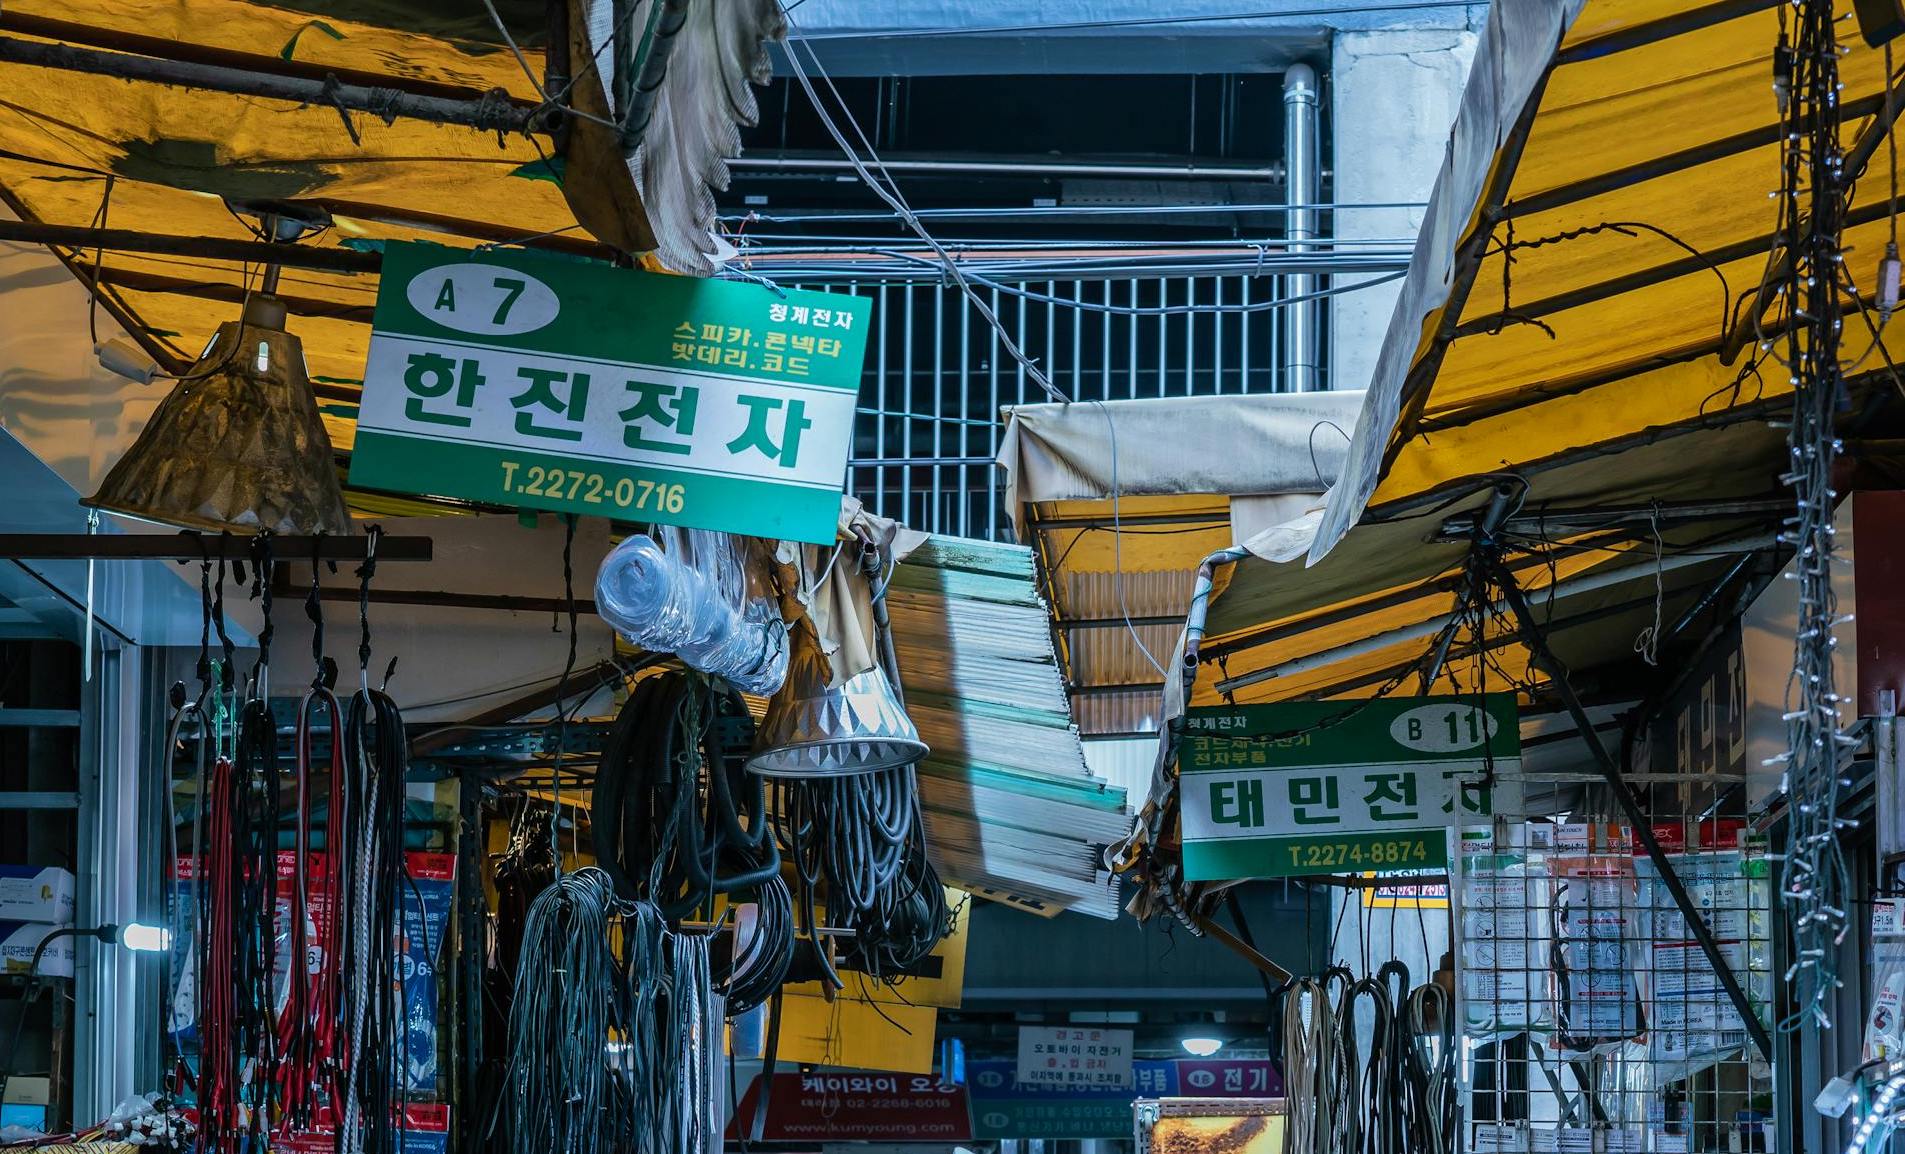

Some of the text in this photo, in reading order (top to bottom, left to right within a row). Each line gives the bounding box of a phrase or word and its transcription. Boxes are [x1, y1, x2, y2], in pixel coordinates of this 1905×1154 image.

[434, 277, 526, 325] A 7
[769, 303, 853, 330] 청계전자
[673, 321, 842, 358] 스피카.콘넥타
[672, 342, 810, 375] 밧데리.코드
[403, 352, 812, 468] 한진전자
[501, 461, 686, 514] T.2272-0716
[1408, 711, 1480, 744] B 11
[1288, 840, 1427, 867] T.2274-8874
[1034, 1044, 1121, 1056] 오토바이 자전거
[802, 1077, 897, 1093] 케이와이
[784, 1123, 955, 1133] www.kumyoung.com
